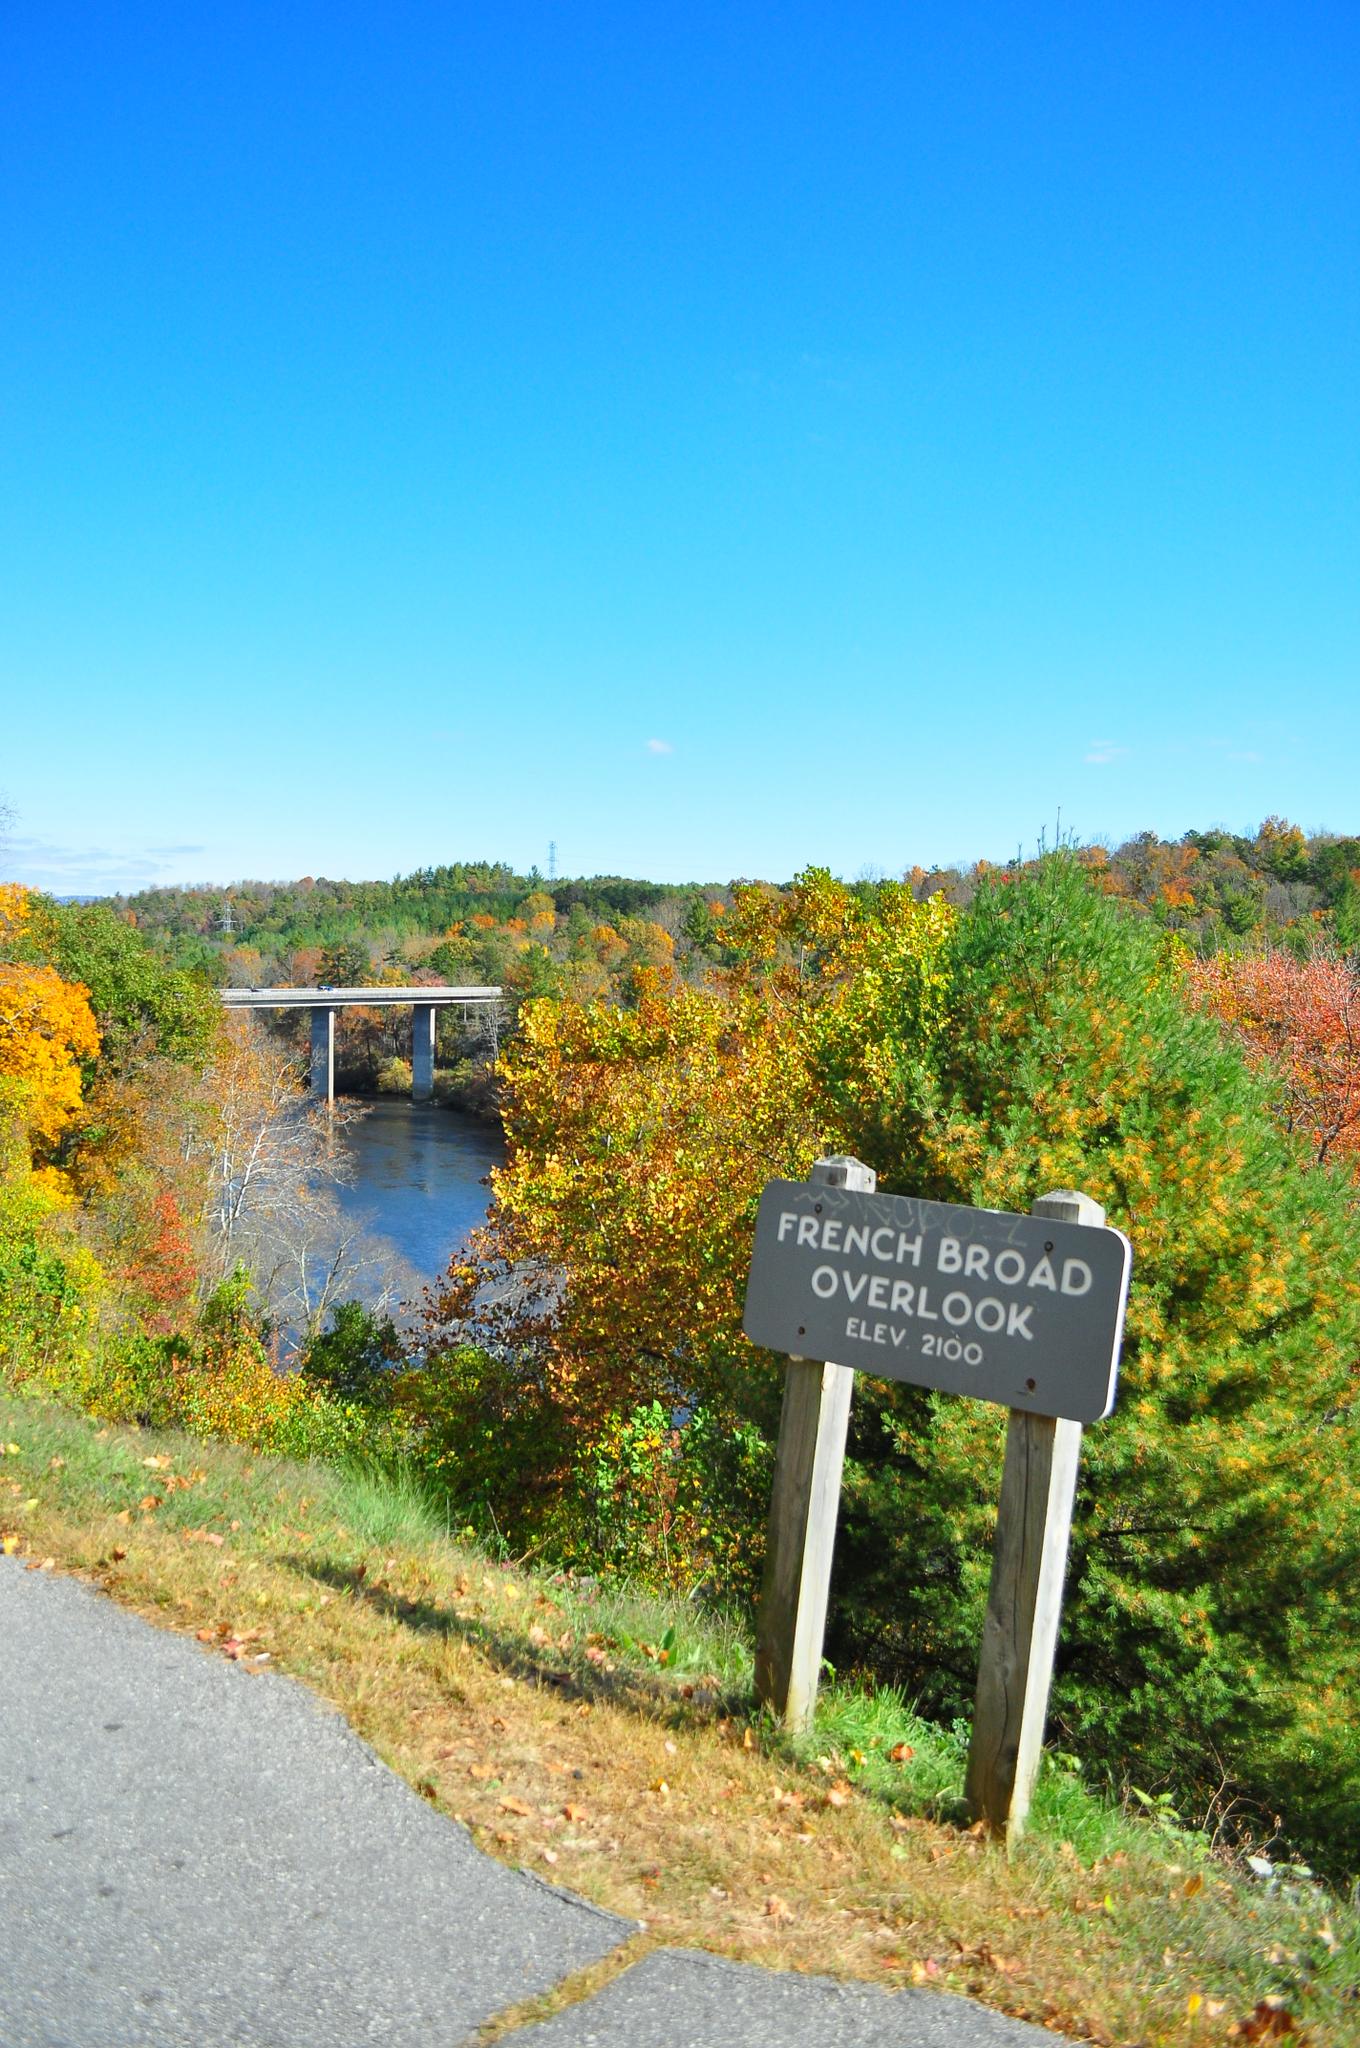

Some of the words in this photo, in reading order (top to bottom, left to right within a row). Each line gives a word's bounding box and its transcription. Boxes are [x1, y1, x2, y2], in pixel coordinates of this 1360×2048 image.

[777, 1212, 922, 1266] FRENCH
[937, 1237, 1093, 1297] BROAD
[811, 1266, 1034, 1341] OVERLOOK
[920, 1333, 984, 1366] 2100
